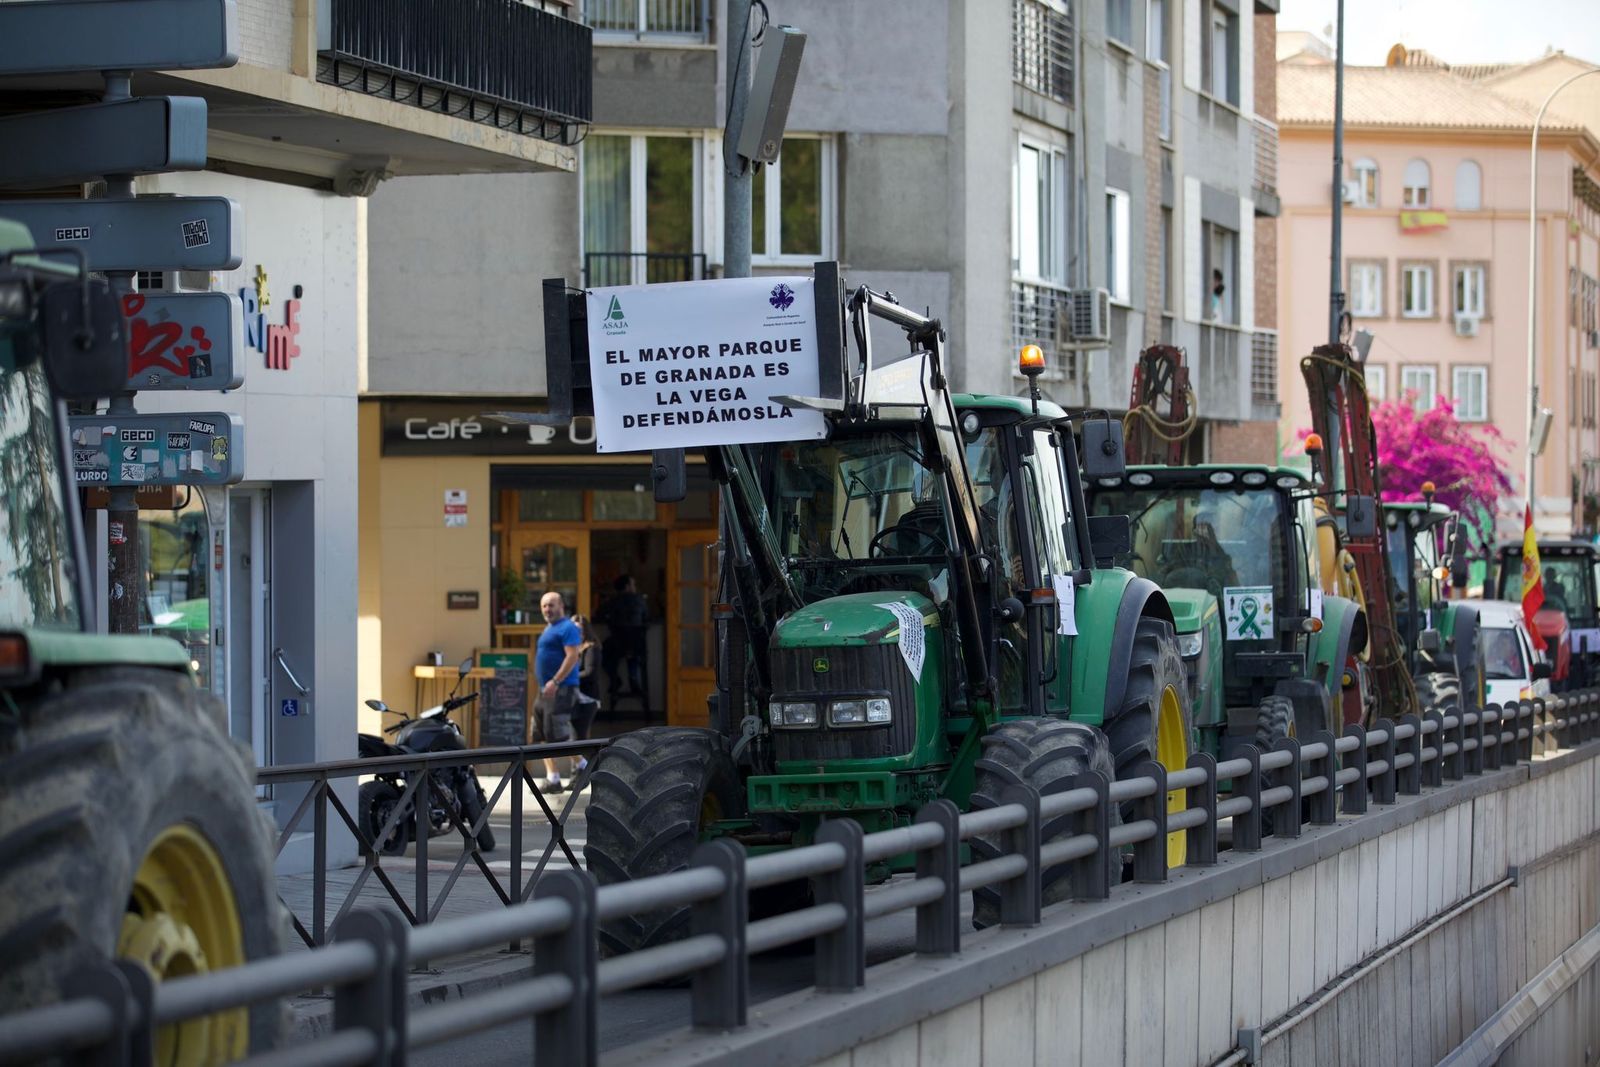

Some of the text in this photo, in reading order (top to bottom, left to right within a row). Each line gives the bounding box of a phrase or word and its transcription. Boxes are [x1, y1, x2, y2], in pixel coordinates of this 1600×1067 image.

[602, 321, 629, 330] ASAJA
[605, 338, 802, 364] EL MAYOR PARQUE
[620, 362, 790, 386] DE GRANADA ES
[656, 387, 747, 405] LA VEGA
[190, 420, 215, 434] FARLOPA
[405, 416, 482, 440] Café
[623, 406, 793, 429] DEFENDÁMOSLA
